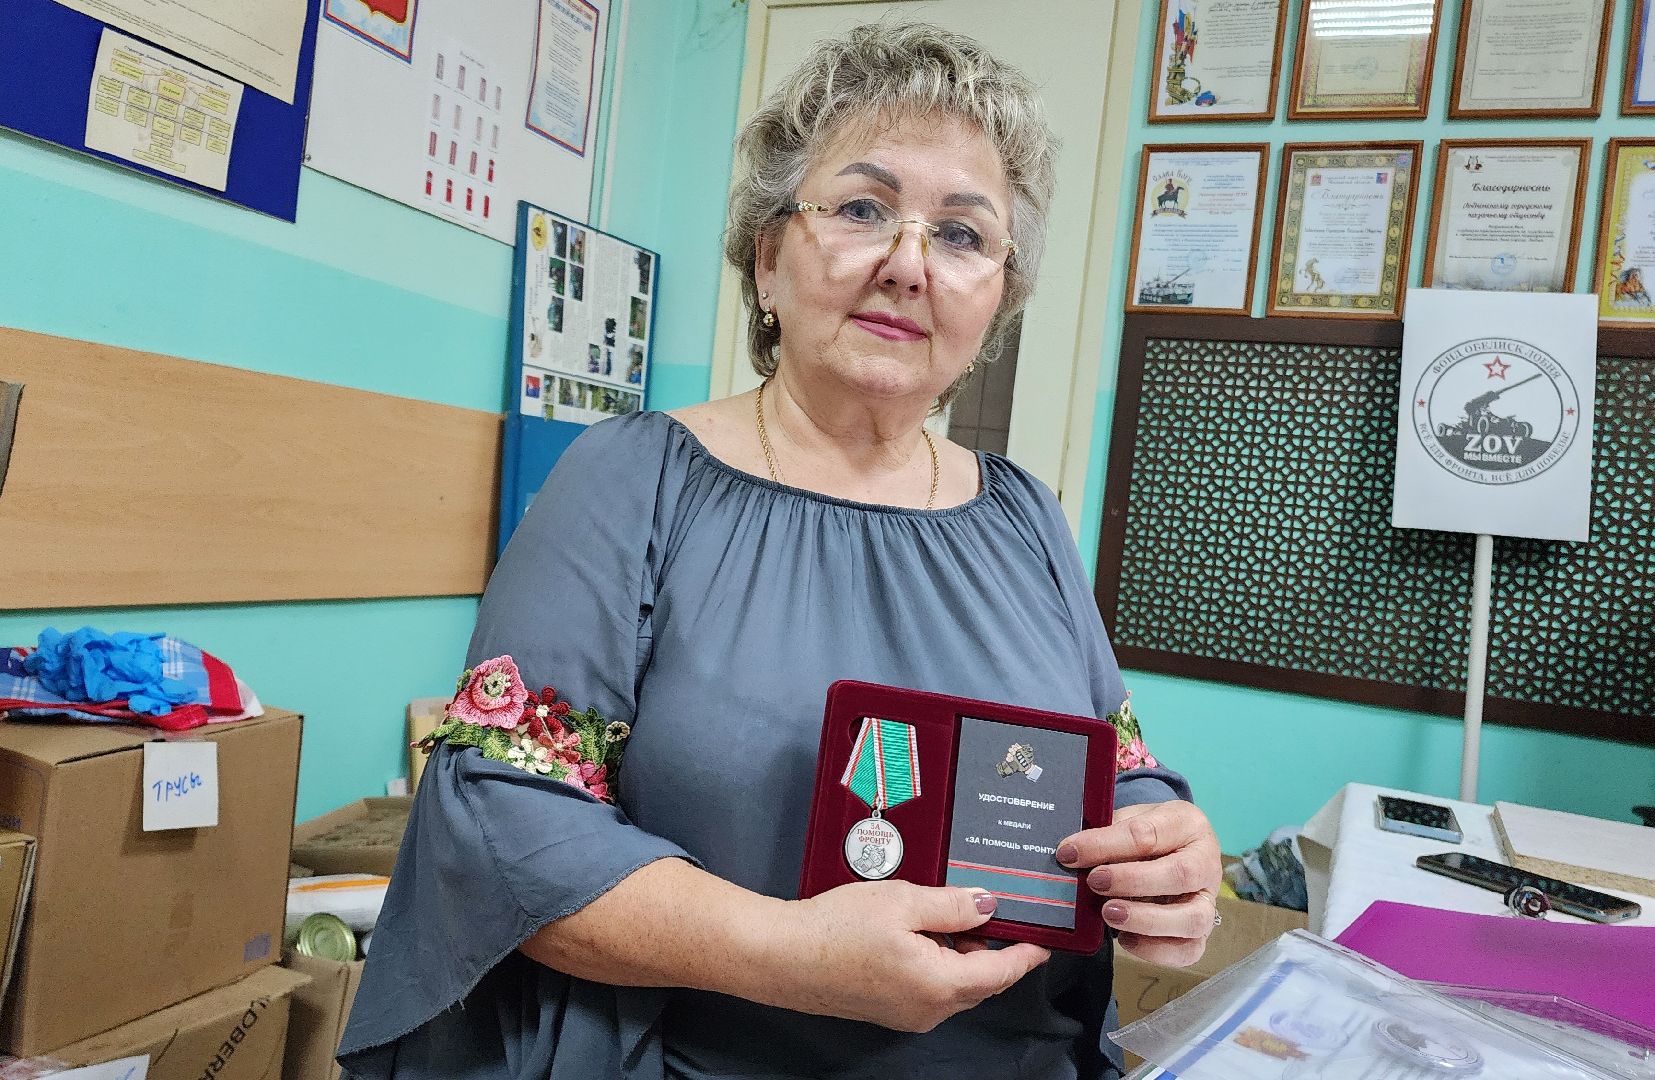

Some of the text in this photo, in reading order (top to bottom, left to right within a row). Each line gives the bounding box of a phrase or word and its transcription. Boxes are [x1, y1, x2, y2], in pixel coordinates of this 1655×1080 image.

[1432, 341, 1562, 379] ФОНД ОБЕЛИСК ЛОБНЯ
[1463, 433, 1523, 455] ZOV
[1463, 452, 1523, 464] МЫ ВМЕСТЕ
[978, 792, 1055, 811] УДОСТОВЕРЕНИЕ
[870, 822, 881, 830] ЗА
[1003, 820, 1032, 830] МЕДАЛИ
[857, 828, 895, 838] ПОМОЩЬ
[858, 835, 891, 846] ФРОНТУ
[982, 837, 1021, 850] ПОМОЩЬ
